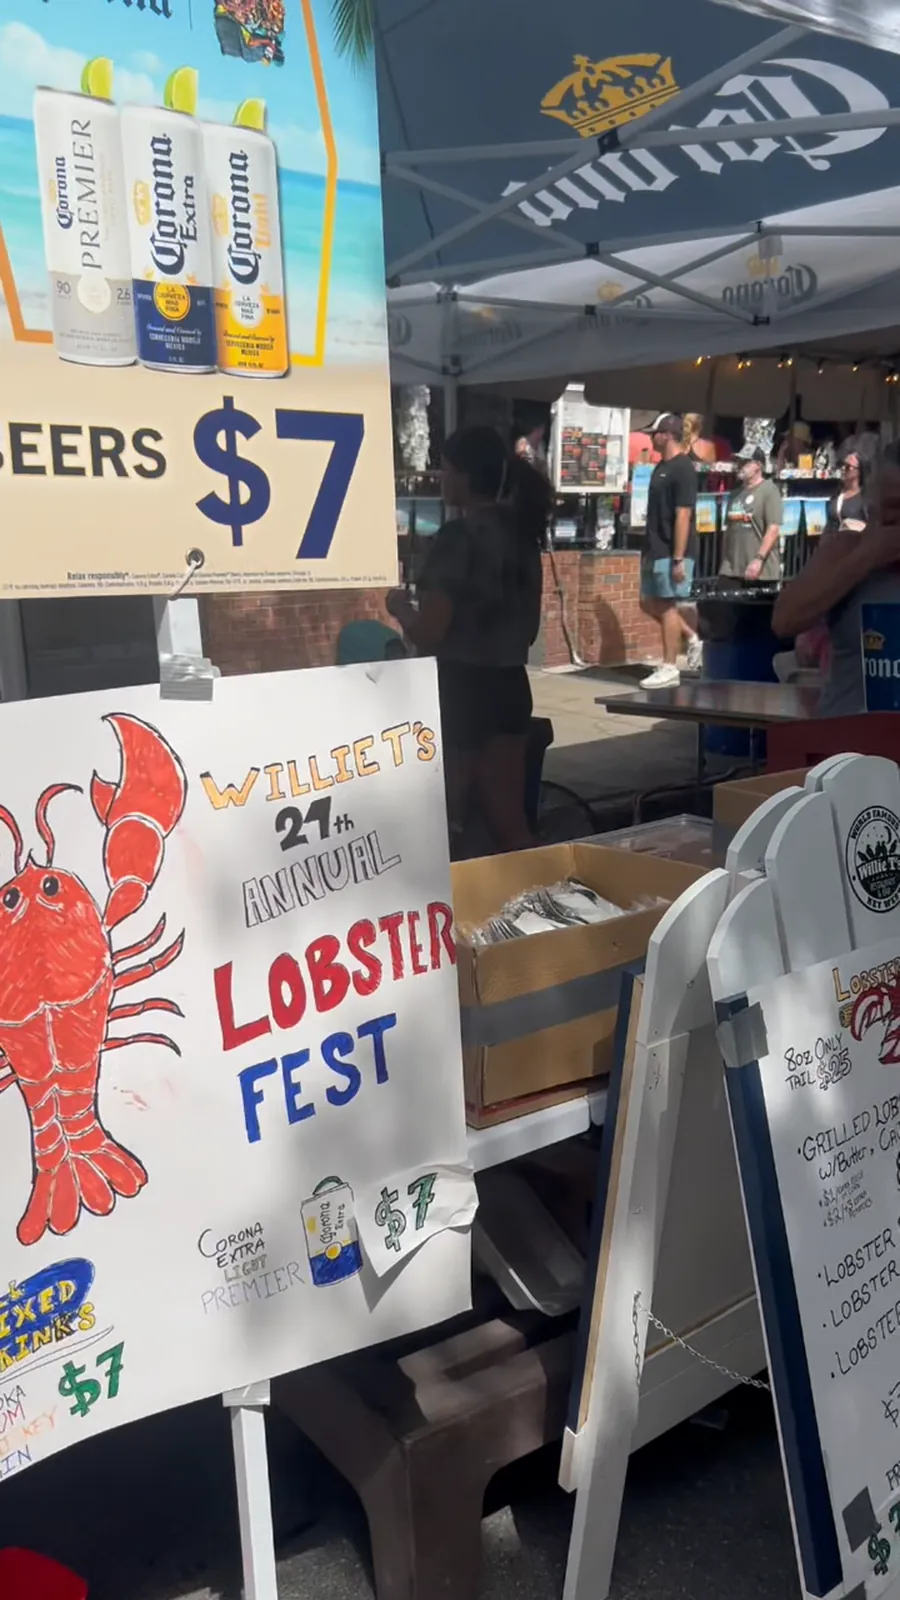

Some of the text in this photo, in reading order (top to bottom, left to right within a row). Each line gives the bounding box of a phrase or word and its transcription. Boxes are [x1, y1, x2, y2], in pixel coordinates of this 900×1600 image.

[55, 156, 74, 230] Corona
[71, 119, 103, 270] PREMIER
[150, 135, 187, 276] Corona
[180, 175, 198, 242] Extra
[227, 151, 261, 285] Corona
[57, 281, 71, 294] 90
[0, 395, 365, 560] EERS $7
[243, 830, 402, 928] ANNUAL
[214, 901, 457, 1052] LOBSTER
[237, 1013, 397, 1143] FEST
[785, 1047, 852, 1091] TAIL $25
[802, 1092, 900, 1162] GRILLED LOB
[197, 1221, 265, 1259] CORONA
[374, 1172, 439, 1253] $7
[200, 1261, 306, 1315] PREMIER
[216, 1238, 266, 1269] EXTRA
[823, 1228, 897, 1287] LOBSTER
[0, 1280, 77, 1339] IXED
[830, 1259, 900, 1328] LOBSTER
[57, 1340, 125, 1418] $7
[0, 1443, 33, 1480] IN
